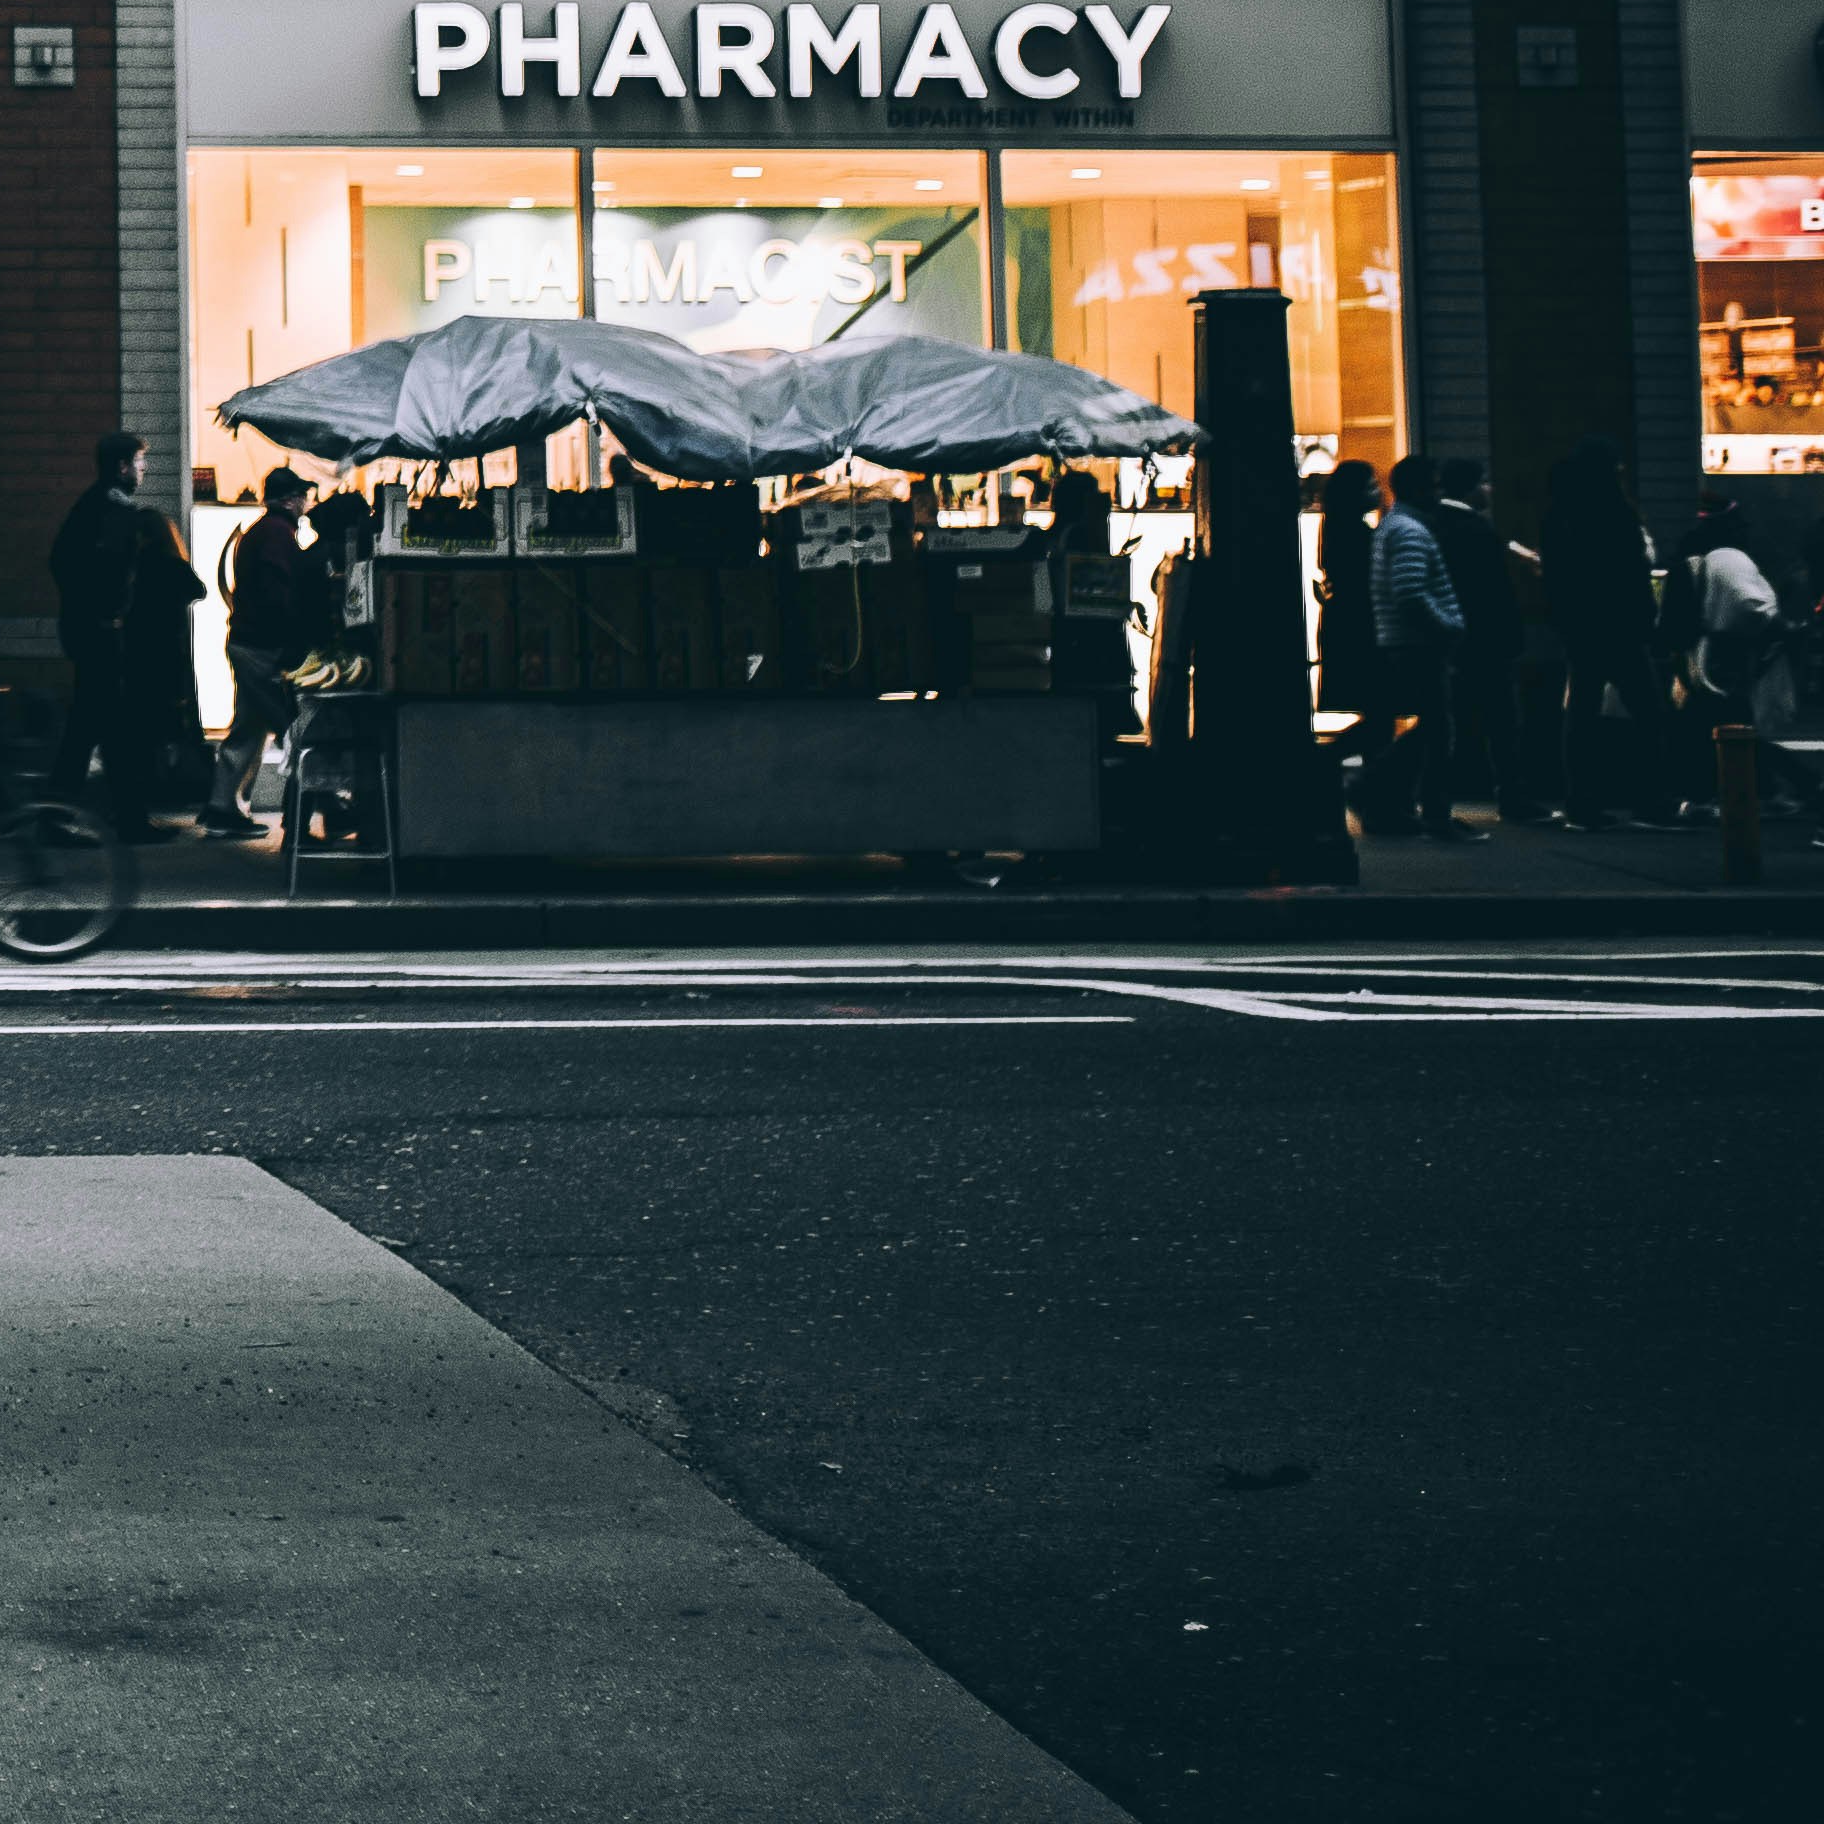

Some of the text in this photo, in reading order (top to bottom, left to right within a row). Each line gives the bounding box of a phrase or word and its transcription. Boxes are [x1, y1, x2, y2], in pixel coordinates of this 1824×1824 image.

[412, 1, 1173, 100] PHARMACY
[886, 106, 1135, 129] DEPARTMENT WITHIN
